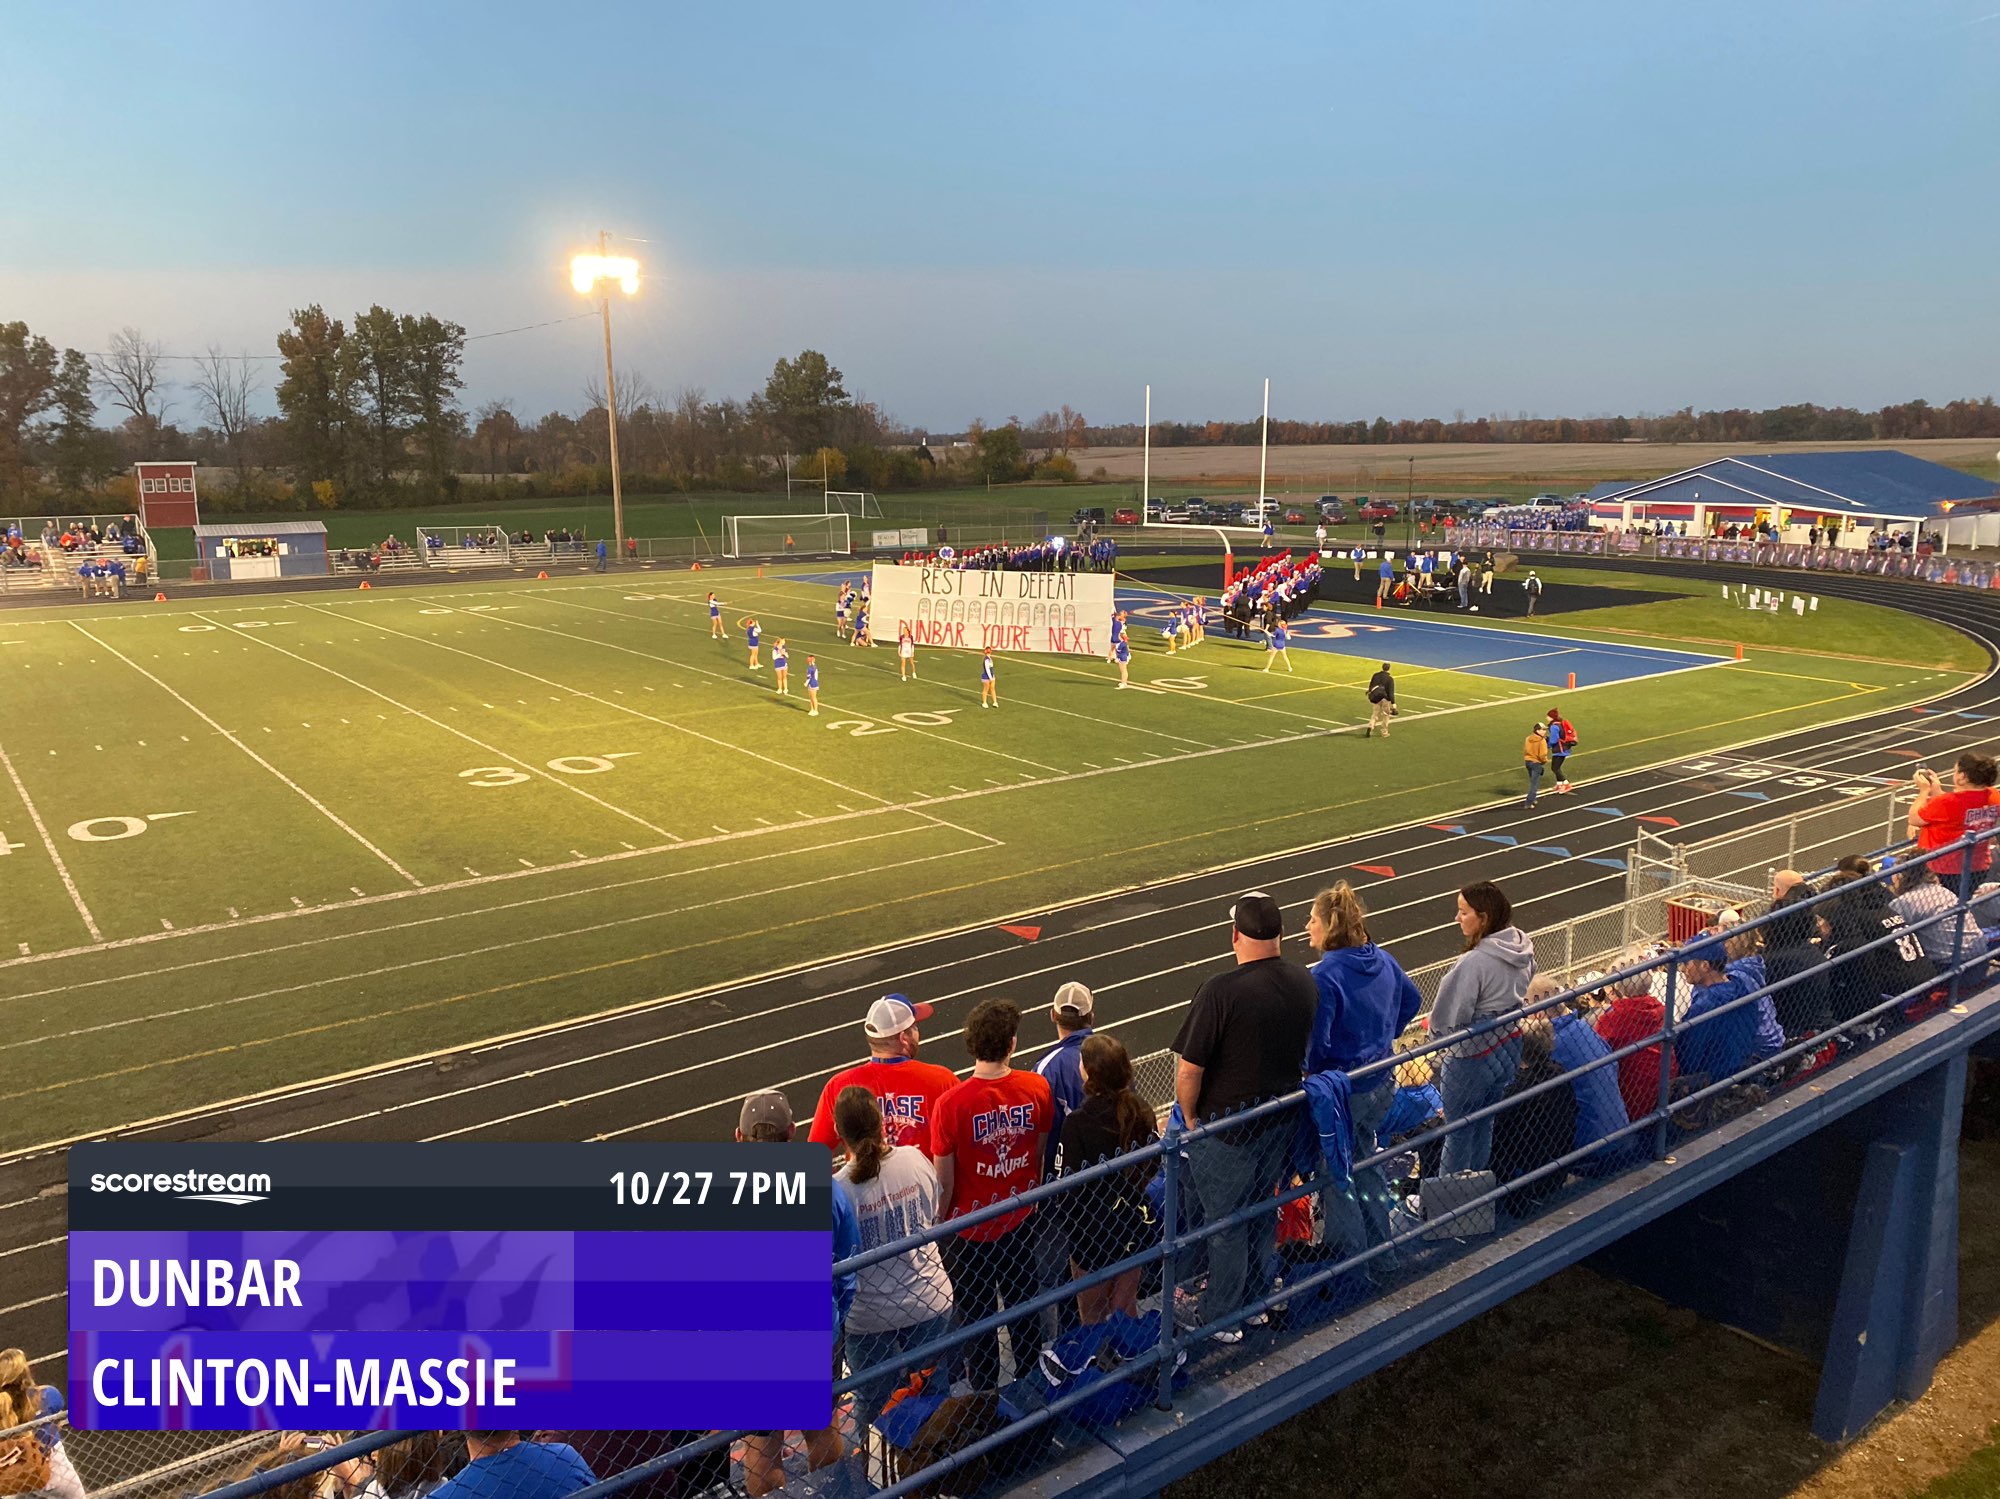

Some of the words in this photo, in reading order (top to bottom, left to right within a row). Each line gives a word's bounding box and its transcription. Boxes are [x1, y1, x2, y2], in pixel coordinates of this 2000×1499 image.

[921, 568, 966, 596] REST
[979, 571, 1004, 598] IN
[1019, 572, 1076, 600] DEFEAT
[826, 712, 953, 736] 20
[458, 756, 614, 787] 30
[1965, 804, 2000, 824] CHAS
[973, 1102, 1034, 1142] CHASE
